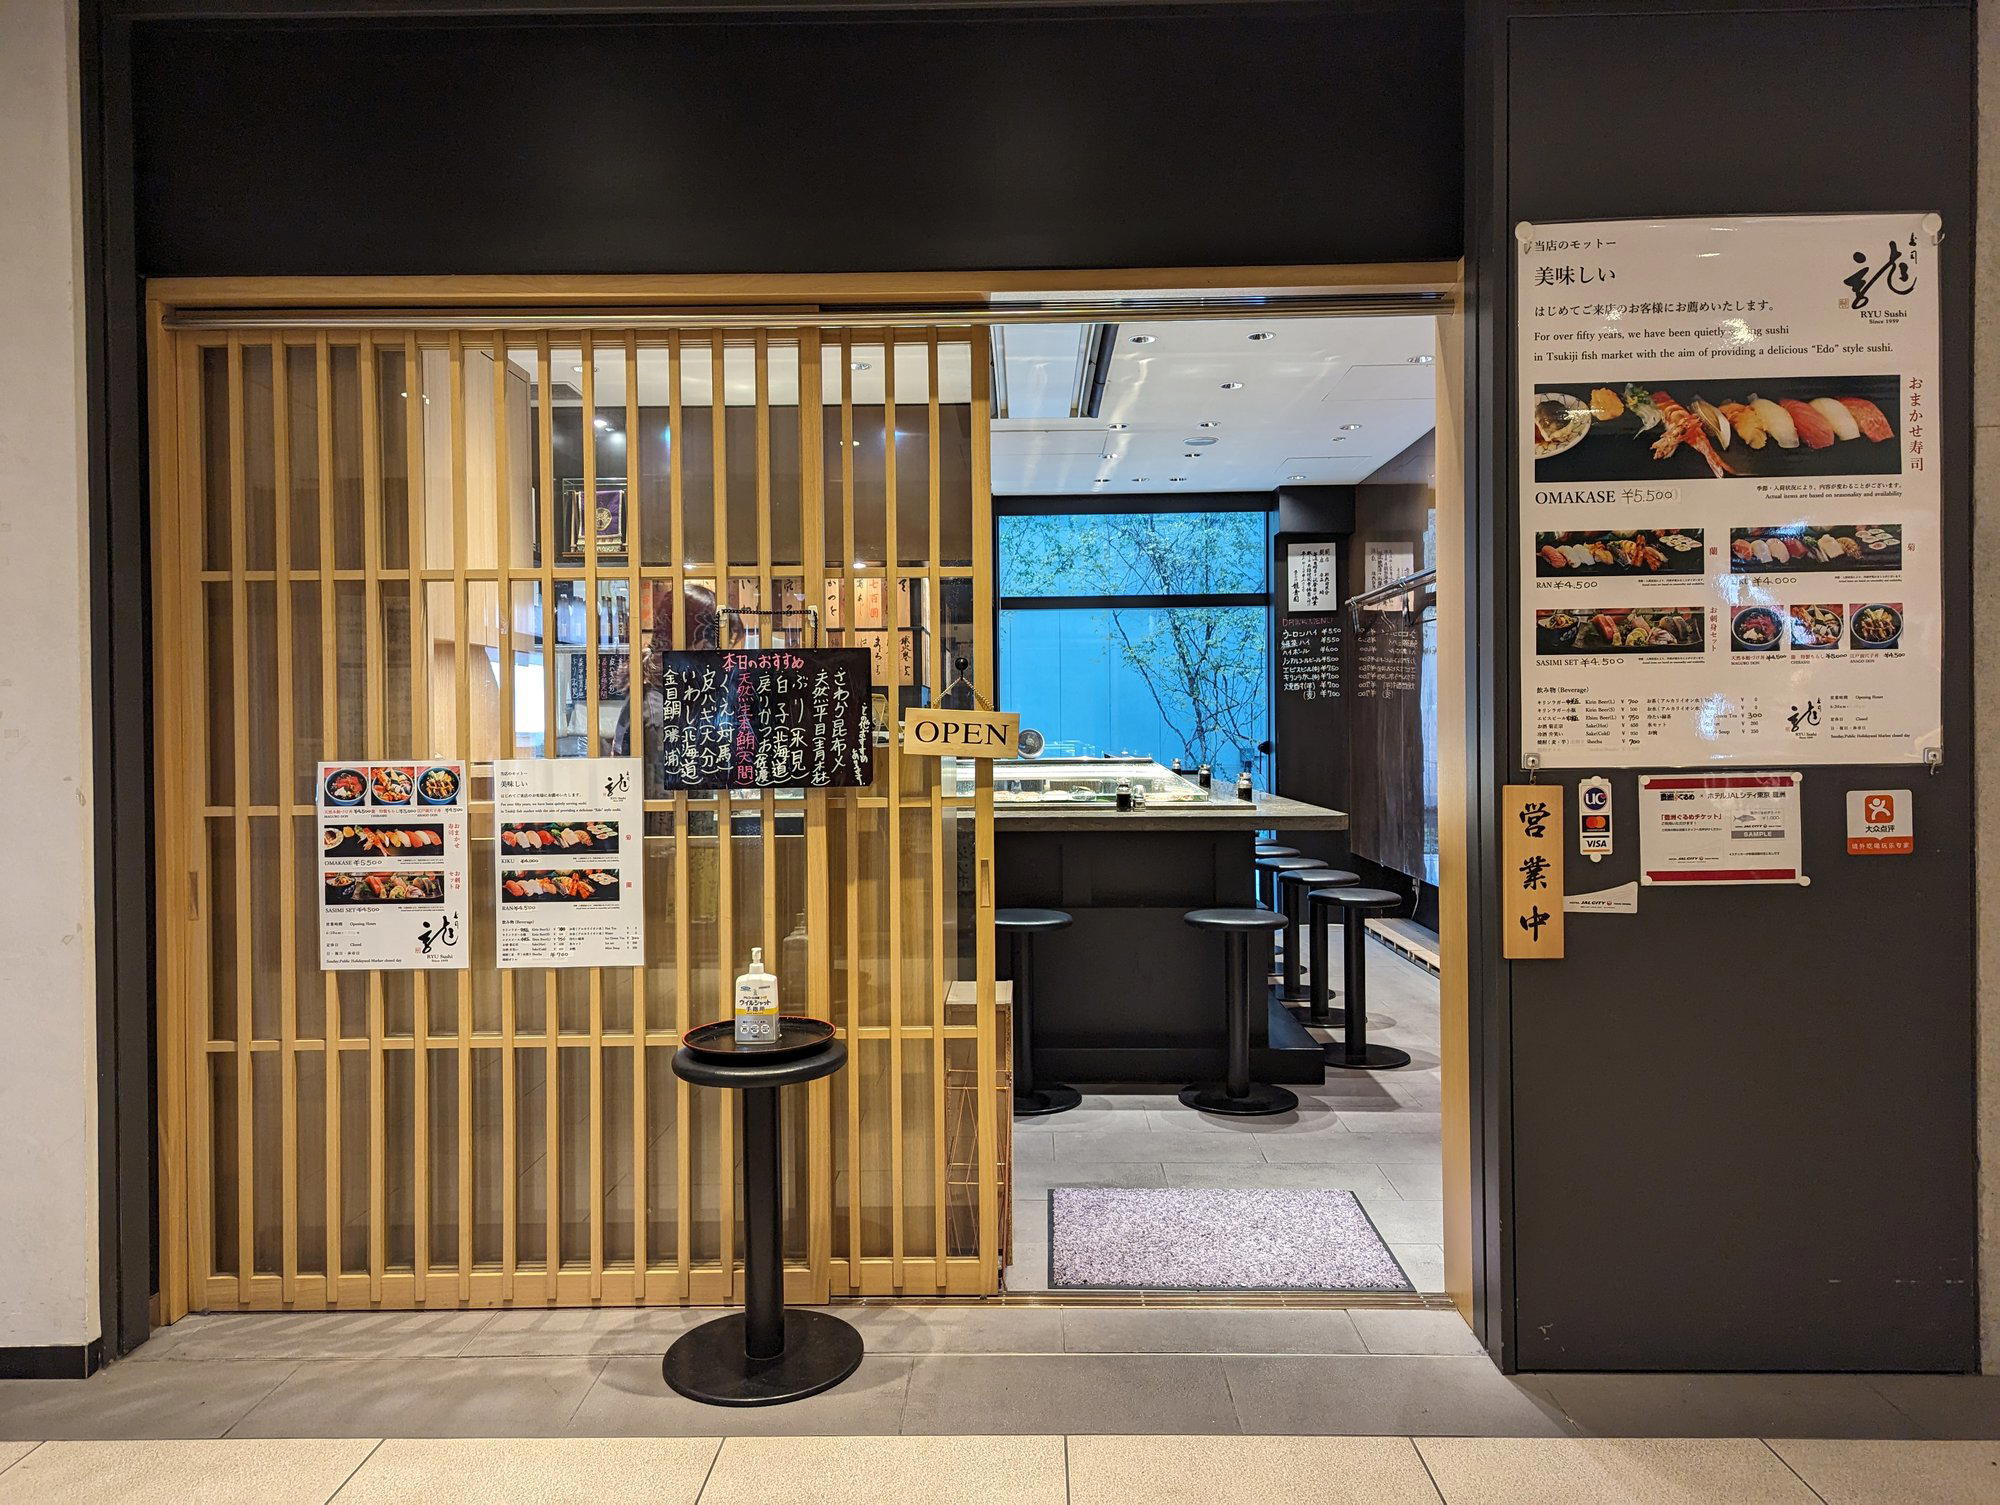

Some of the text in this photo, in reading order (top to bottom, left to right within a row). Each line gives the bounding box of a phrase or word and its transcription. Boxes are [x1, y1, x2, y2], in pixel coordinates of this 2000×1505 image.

[1534, 238, 1617, 252] 当店のモットー
[1534, 265, 1616, 286] 美味しい
[1534, 300, 1774, 317] はじめてご来店のお客様にお薦めいたします。
[1860, 310, 1907, 319] RYU Sushi
[1534, 331, 1551, 342] For
[1553, 333, 1573, 341] over
[1576, 330, 1595, 342] fifty
[1598, 331, 1625, 343] years,
[1628, 331, 1641, 339] we
[1643, 329, 1666, 339] have
[1668, 328, 1691, 338] been
[1693, 326, 1726, 339] quietly
[1765, 325, 1790, 335] sushi
[1533, 353, 1543, 362] in
[1545, 351, 1578, 363] Tsukiji
[1581, 350, 1598, 360] fish
[1601, 350, 1633, 360] market
[1636, 349, 1658, 359] with
[1660, 348, 1675, 358] the
[1677, 348, 1695, 358] aim
[1698, 347, 1709, 357] of
[1711, 346, 1756, 359] providing
[1767, 345, 1808, 355] delicious
[1811, 344, 1840, 354] “Edo”
[1842, 343, 1864, 354] style
[1867, 343, 1894, 353] sushi.
[1908, 376, 1924, 472] おまかせ寿司
[1534, 490, 1616, 505] OMAKASE
[1874, 490, 1902, 499] availability
[1536, 581, 1552, 589] RAN
[1709, 606, 1718, 652] お刺身セット
[1283, 629, 1317, 640] ウーロンハイ
[1320, 636, 1340, 644] ¥550
[722, 652, 805, 671] 本日のおすすめ
[1536, 659, 1562, 667] SASIMI
[1564, 658, 1579, 667] SET
[1320, 672, 1339, 680] ¥700
[1320, 681, 1340, 689] ¥700
[1320, 689, 1340, 698] ¥700
[915, 720, 1010, 746] OPEN
[500, 780, 528, 788] 美味しい
[1661, 813, 1722, 821] 「豊洲ぐるめチケット」
[1865, 825, 1895, 833] 大众点评
[1586, 840, 1607, 848] VISA
[324, 859, 353, 867] OMAKASE
[1519, 802, 1551, 942] 営業中
